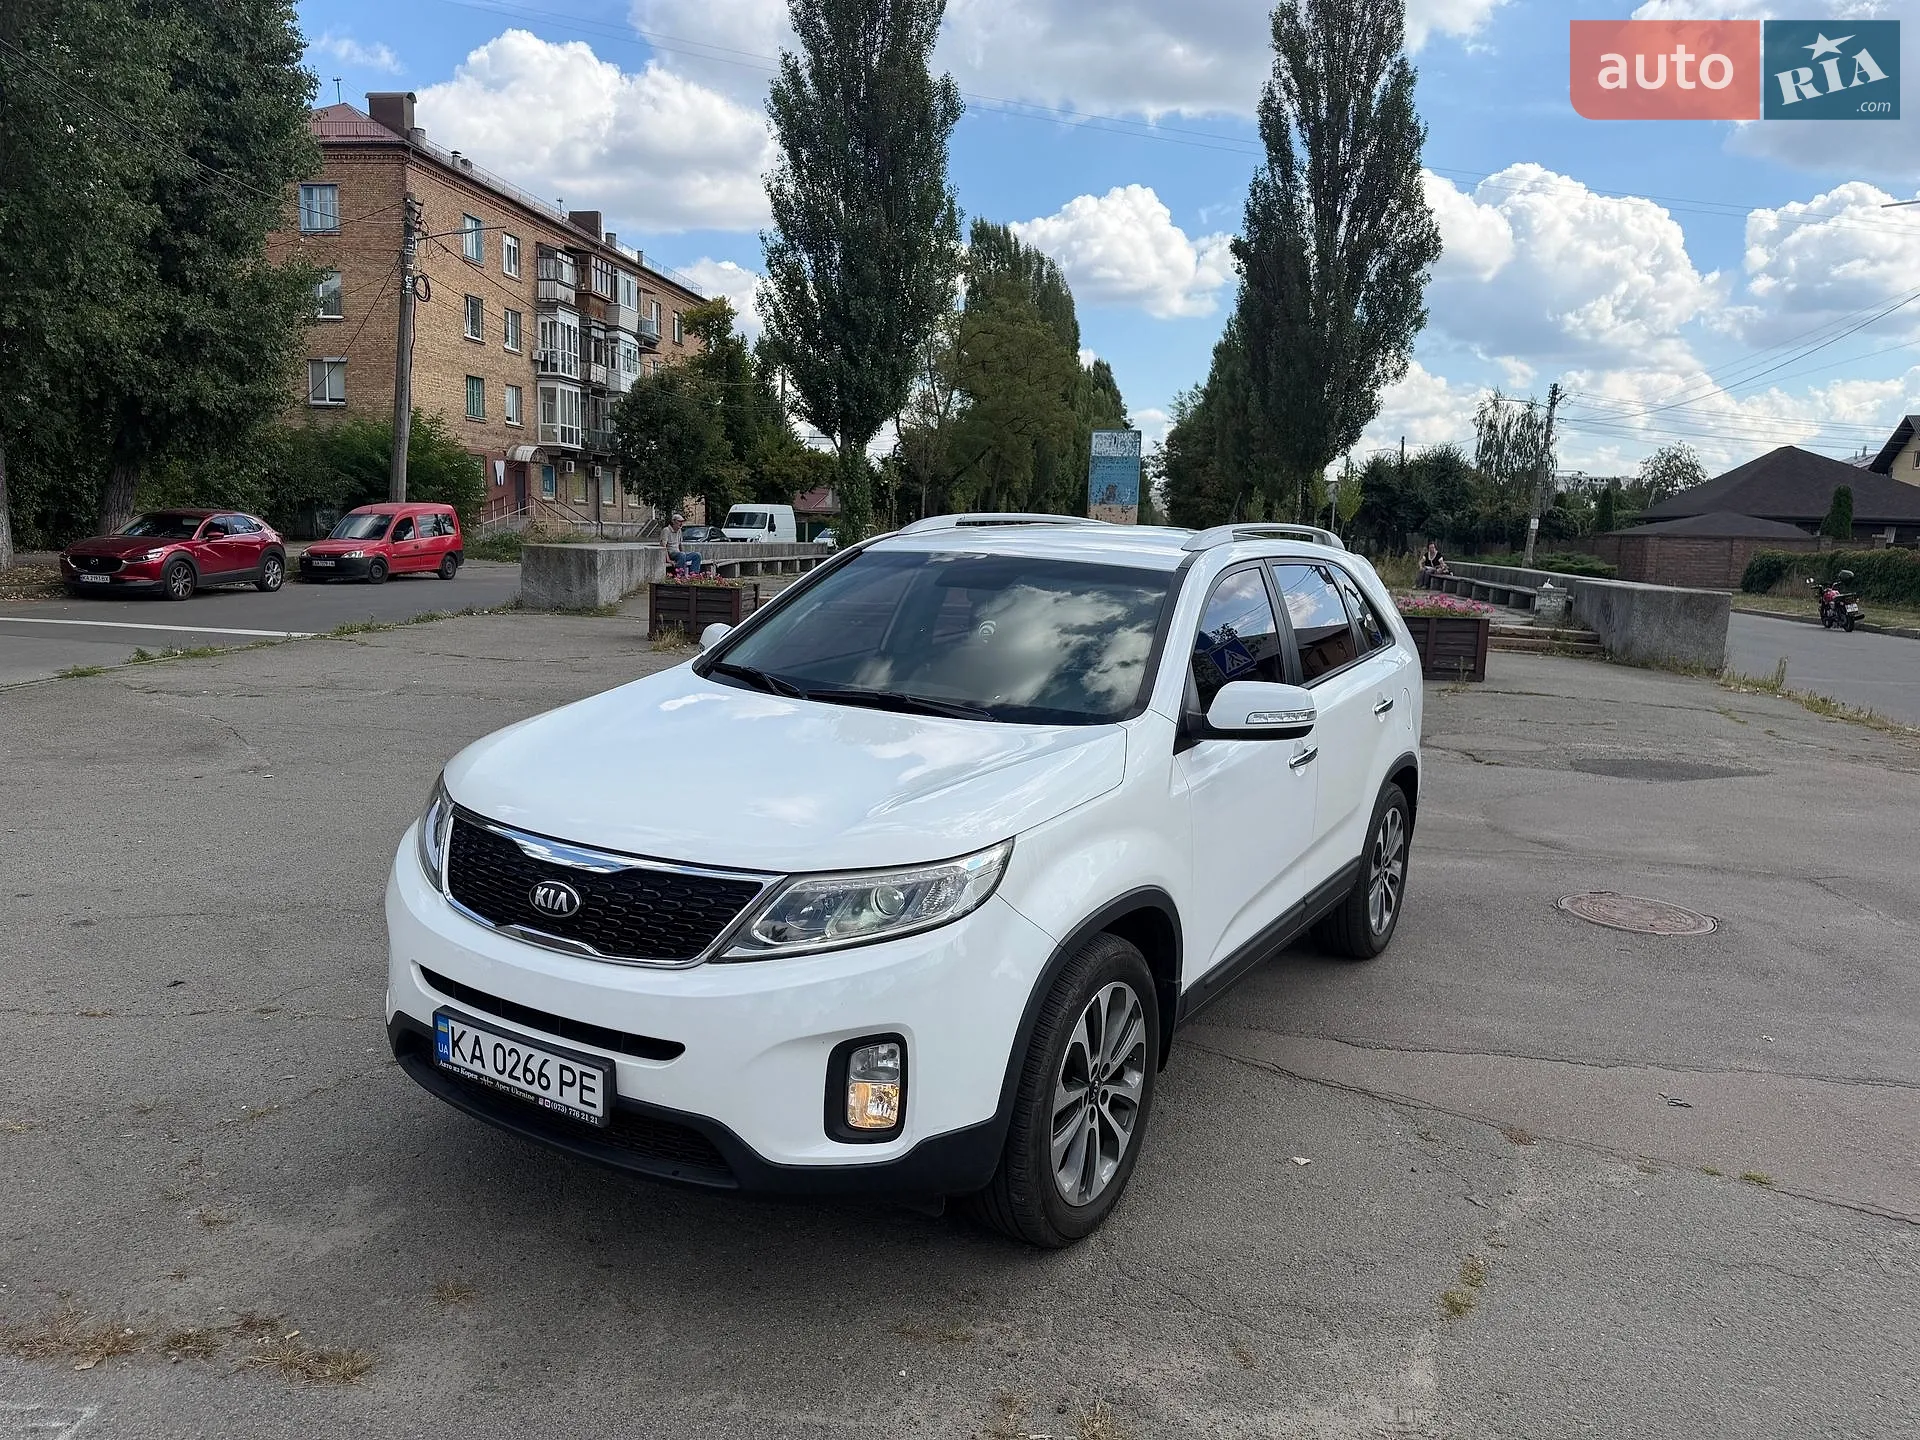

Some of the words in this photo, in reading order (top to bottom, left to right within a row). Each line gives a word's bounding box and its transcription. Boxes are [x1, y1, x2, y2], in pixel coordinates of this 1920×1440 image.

[534, 885, 569, 912] KIA
[438, 1042, 449, 1055] UA
[450, 1025, 487, 1069] KA
[493, 1042, 551, 1091] 0266
[558, 1063, 597, 1109] PE
